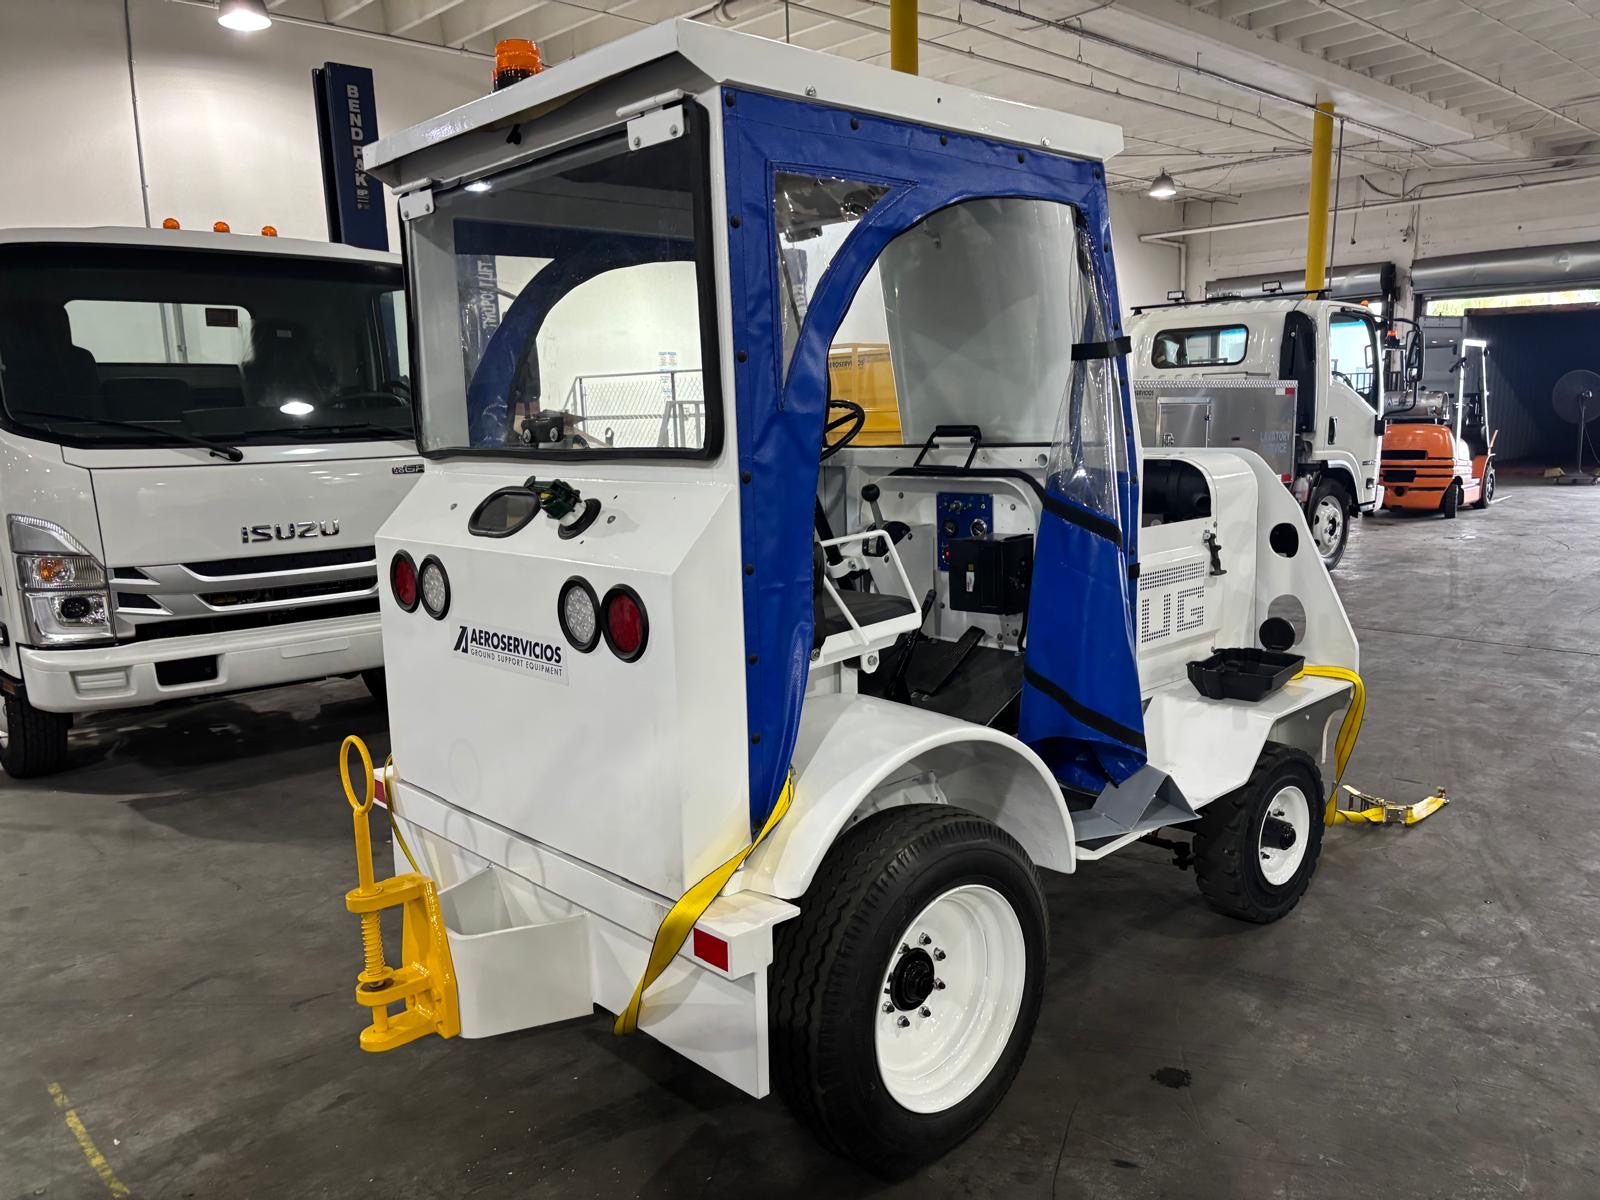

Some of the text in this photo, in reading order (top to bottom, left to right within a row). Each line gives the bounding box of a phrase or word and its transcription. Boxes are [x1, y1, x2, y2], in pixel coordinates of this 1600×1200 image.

[346, 84, 364, 141] BEND
[352, 145, 369, 187] PAK
[477, 260, 495, 280] LIFT
[1260, 431, 1291, 441] LAVATORY
[240, 518, 340, 544] ISUZU
[470, 628, 562, 664] AEROSERVICIOS
[470, 649, 562, 677] GROUND SUPPORT EQUIPMENT
